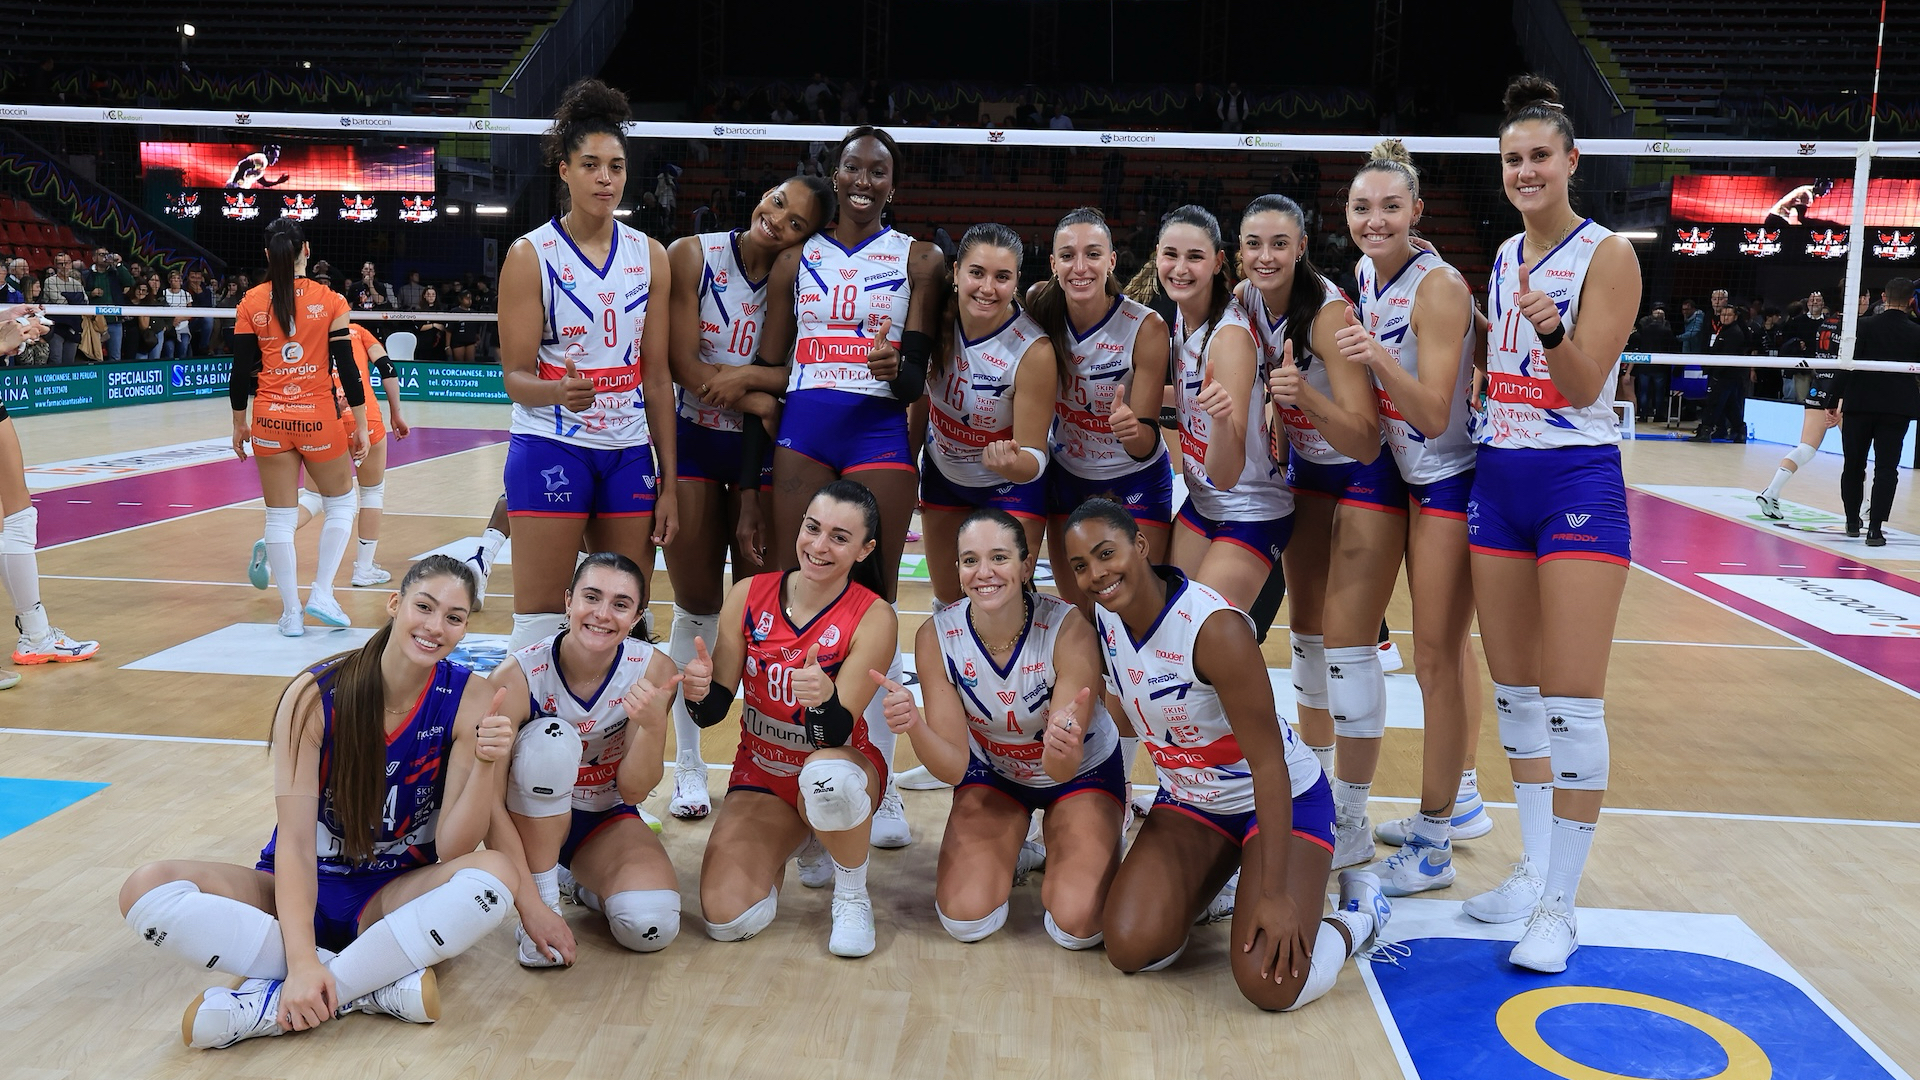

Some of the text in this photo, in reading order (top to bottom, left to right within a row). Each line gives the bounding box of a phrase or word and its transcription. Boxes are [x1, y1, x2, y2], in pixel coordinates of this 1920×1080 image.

[352, 117, 392, 127] bartoccini
[726, 126, 767, 136] bartoccini
[1113, 134, 1156, 143] bartoccini
[868, 254, 900, 263] mauden
[864, 270, 899, 282] FREDDY
[1545, 269, 1576, 279] mauden
[800, 294, 821, 305] SYM
[830, 284, 858, 321] 18
[562, 325, 588, 338] SYM
[604, 308, 617, 348] 9
[700, 320, 720, 334] SYM
[1500, 308, 1520, 354] 11
[727, 318, 758, 357] 16
[982, 352, 1008, 368] mauden
[1090, 360, 1122, 372] FREDDY
[34, 375, 48, 383] VIA
[80, 372, 98, 380] PERUGIA
[108, 370, 162, 386] SPECIALISTI
[973, 374, 1002, 382] FREDDY
[441, 380, 478, 388] 075.5173478
[1500, 380, 1542, 400] numia
[108, 384, 164, 399] DEL CONSIGLIO
[943, 372, 968, 412] 15
[976, 396, 995, 406] SKIN
[725, 420, 742, 429] TX
[940, 419, 986, 443] numia
[1088, 450, 1115, 460] TXT
[544, 492, 572, 502] TXT
[1468, 524, 1480, 536] XT
[1552, 532, 1598, 542] FREDDY
[1156, 650, 1184, 662] mauden
[768, 662, 797, 707] 80
[1148, 672, 1178, 686] FREDDY
[1163, 706, 1184, 714] SKIN
[1006, 710, 1024, 735] 4
[1134, 698, 1154, 736] 1
[752, 740, 804, 766] CONTEC
